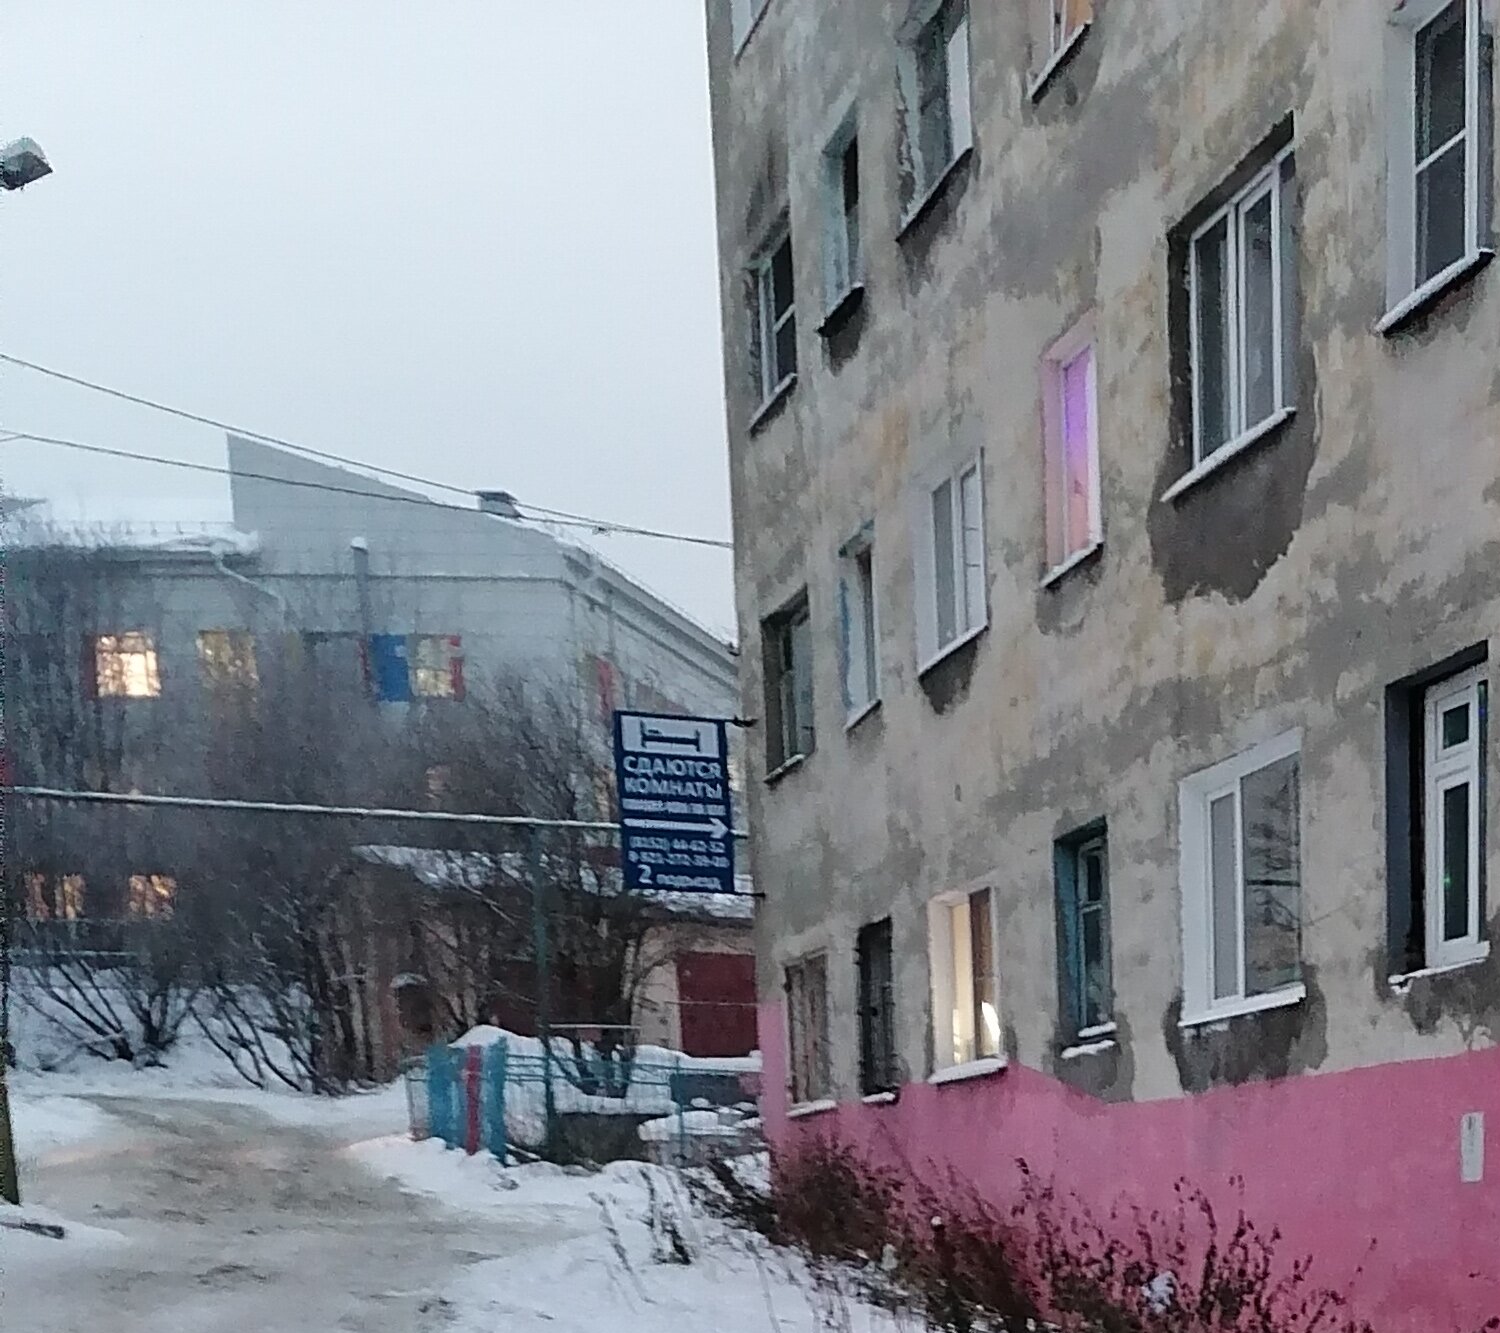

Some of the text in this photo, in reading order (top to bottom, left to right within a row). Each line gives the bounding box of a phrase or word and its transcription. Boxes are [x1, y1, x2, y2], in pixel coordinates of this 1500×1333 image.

[623, 755, 723, 780] СДАЮТСЯ
[624, 777, 723, 800] КОМНАТЫ
[637, 863, 653, 884] 2
